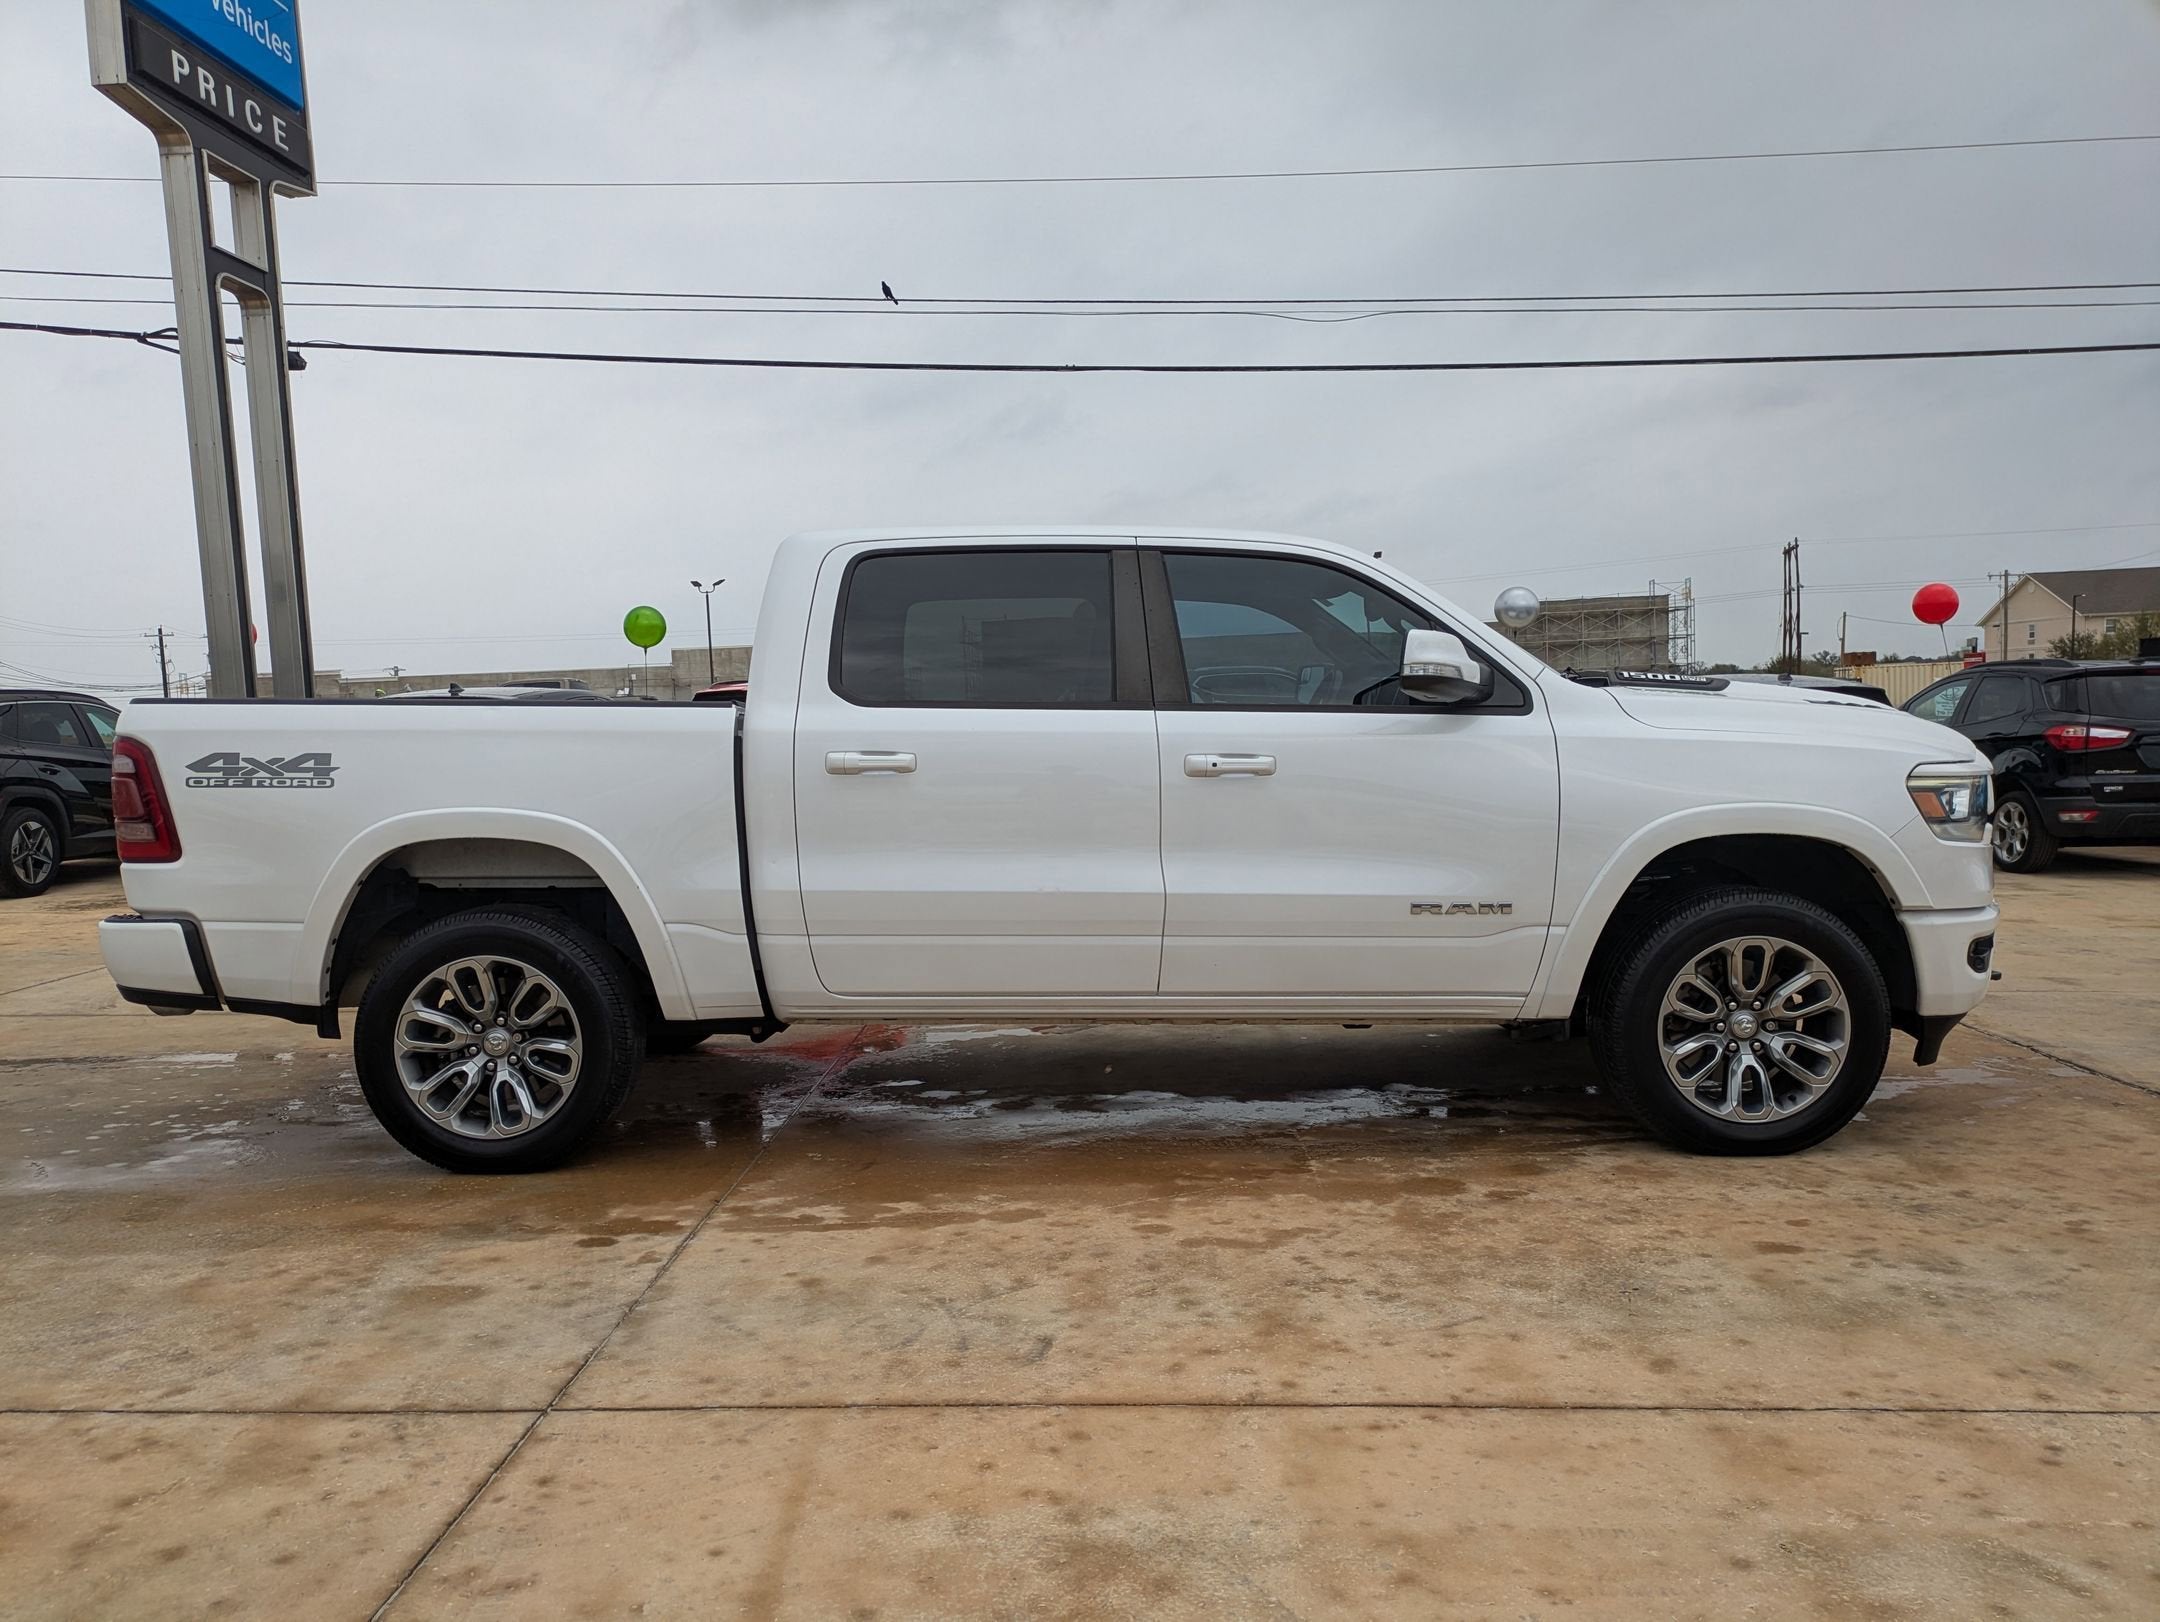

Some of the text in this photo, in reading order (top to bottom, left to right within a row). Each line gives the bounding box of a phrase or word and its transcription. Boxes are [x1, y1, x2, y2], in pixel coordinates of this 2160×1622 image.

[171, 49, 289, 151] PRICE
[1621, 671, 1681, 681] 1500
[188, 778, 331, 787] OFF ROAD
[1410, 902, 1512, 915] RAM
